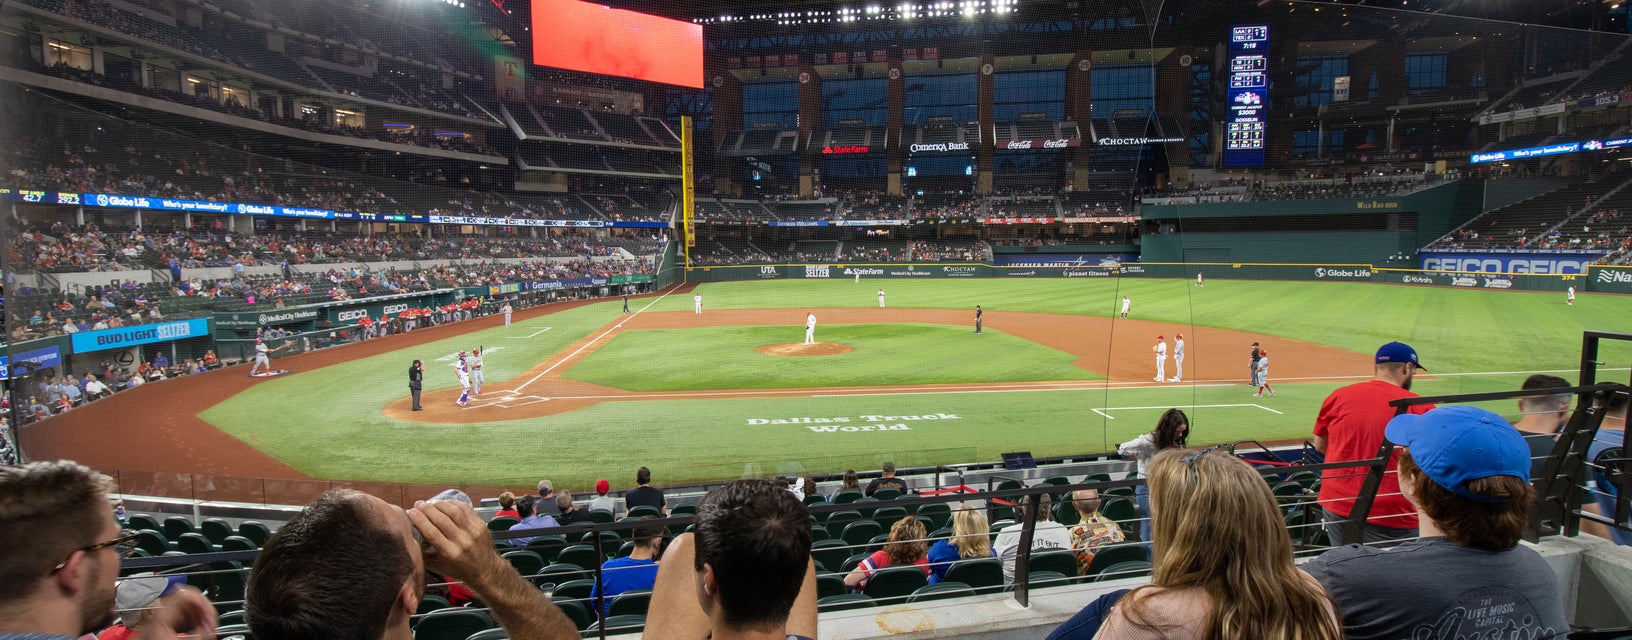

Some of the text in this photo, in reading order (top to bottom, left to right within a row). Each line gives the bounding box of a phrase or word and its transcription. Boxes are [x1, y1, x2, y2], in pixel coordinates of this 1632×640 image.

[1595, 95, 1618, 105] 105.3
[1544, 144, 1578, 153] beneficiary?
[110, 196, 133, 206] Globe
[134, 198, 149, 207] Life
[196, 202, 228, 212] beneficiary?
[246, 205, 263, 213] Globe
[306, 210, 328, 218] beneficiary?
[806, 268, 830, 277] SELTZER
[1424, 258, 1502, 278] GEICO
[532, 280, 562, 289] Germania
[338, 309, 367, 321] GEICO
[383, 304, 408, 314] GEICO
[97, 322, 190, 345] BUD LIGHT SELTZER
[746, 413, 962, 425] Dallas Truck
[806, 424, 912, 433] World
[1468, 602, 1515, 620] LIVE MUSIC
[1475, 616, 1504, 628] CAPITAL
